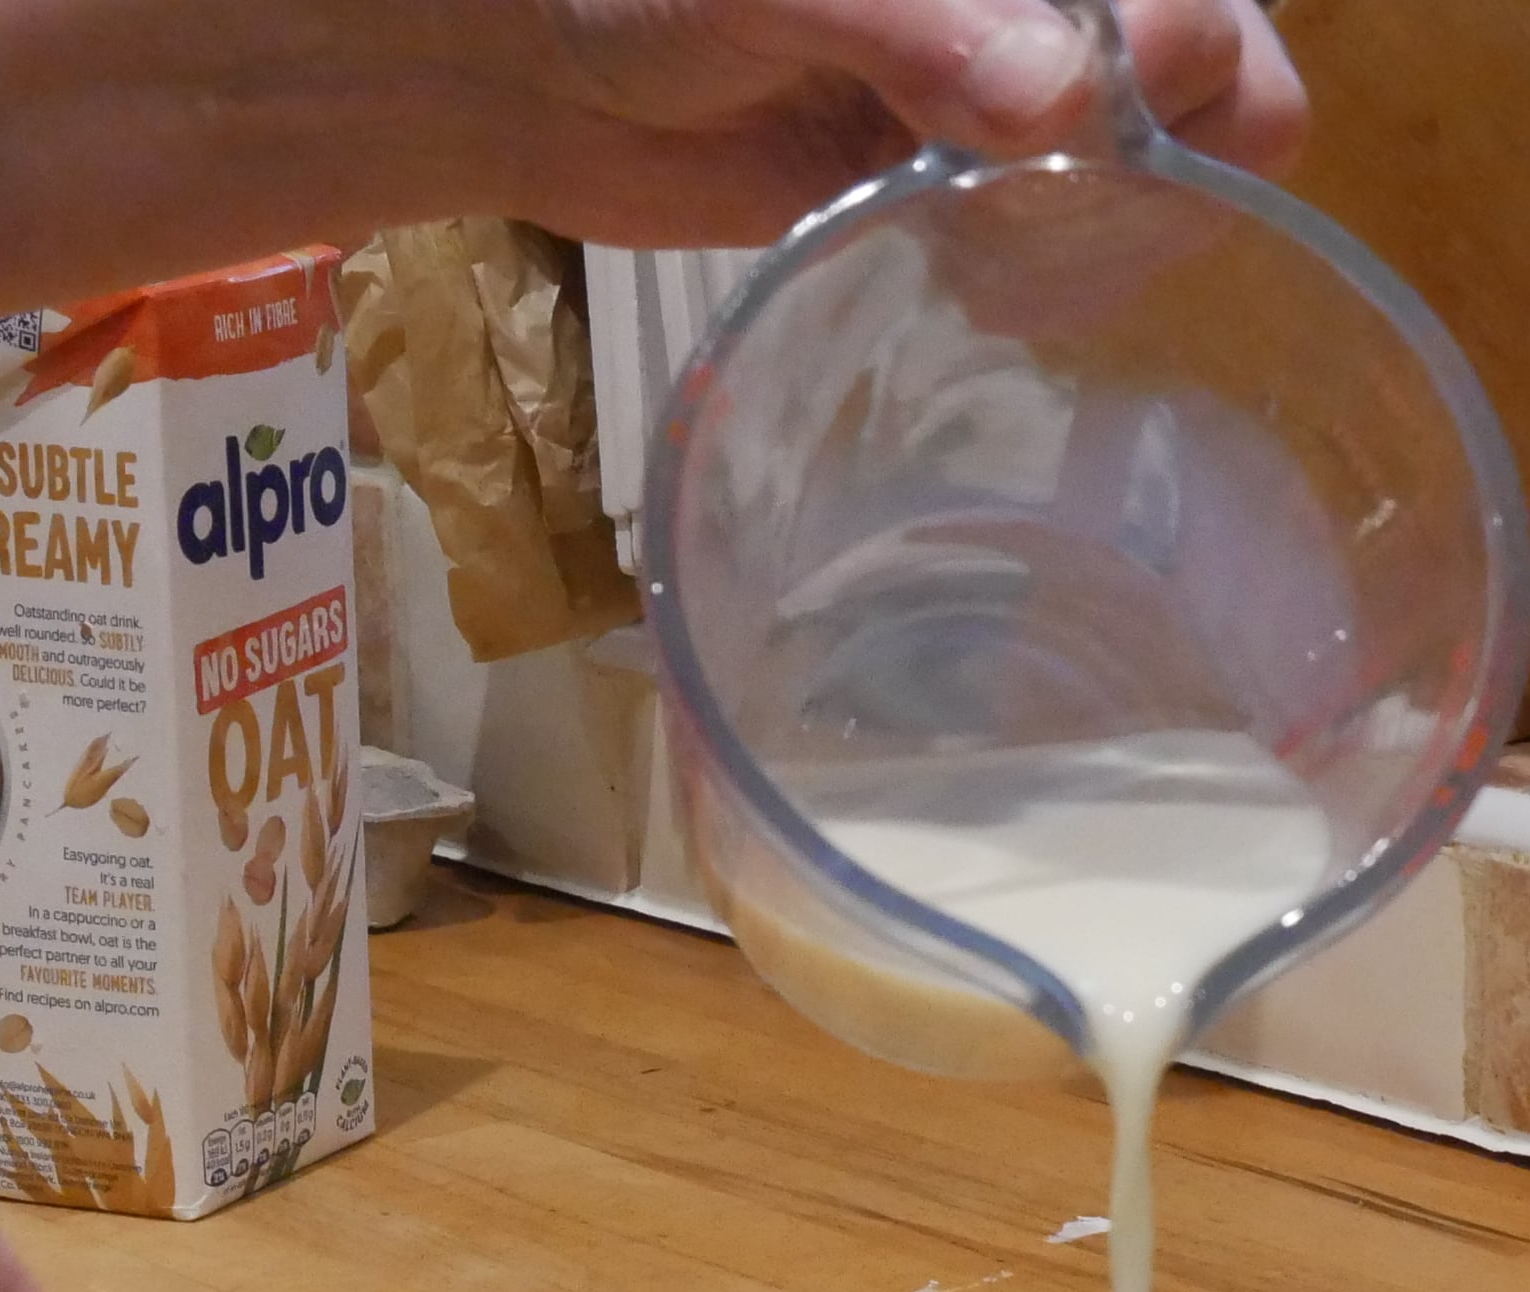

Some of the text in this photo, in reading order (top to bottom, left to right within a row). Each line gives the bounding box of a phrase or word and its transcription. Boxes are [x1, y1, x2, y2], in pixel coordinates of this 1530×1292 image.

[213, 297, 299, 343] RICH IN FIBRE
[177, 435, 347, 581] alpro
[14, 603, 144, 630] Oatstanding oat drink.
[99, 630, 144, 653] SUBTLY
[201, 599, 344, 702] NO SUGARS
[41, 650, 65, 664] and
[67, 652, 146, 674] outrageously
[80, 673, 116, 690] Could
[119, 677, 126, 691] it
[129, 677, 147, 694] be
[62, 694, 147, 714] more perfect?
[208, 661, 346, 811] OAT
[63, 846, 154, 870] Easygoing oat.
[100, 871, 155, 890] It's a real
[64, 885, 156, 913] TEAM PLAYER.
[28, 905, 156, 932] In a cappuccino or a
[1, 922, 157, 951] breakfast bowl, oat is the
[45, 948, 91, 965] partner
[94, 952, 108, 967] to
[110, 955, 125, 969] all
[127, 958, 158, 973] your
[20, 964, 88, 989] FAVOURITE
[26, 992, 71, 1009] recipes
[74, 998, 92, 1011] on
[94, 999, 160, 1017] alpro.com
